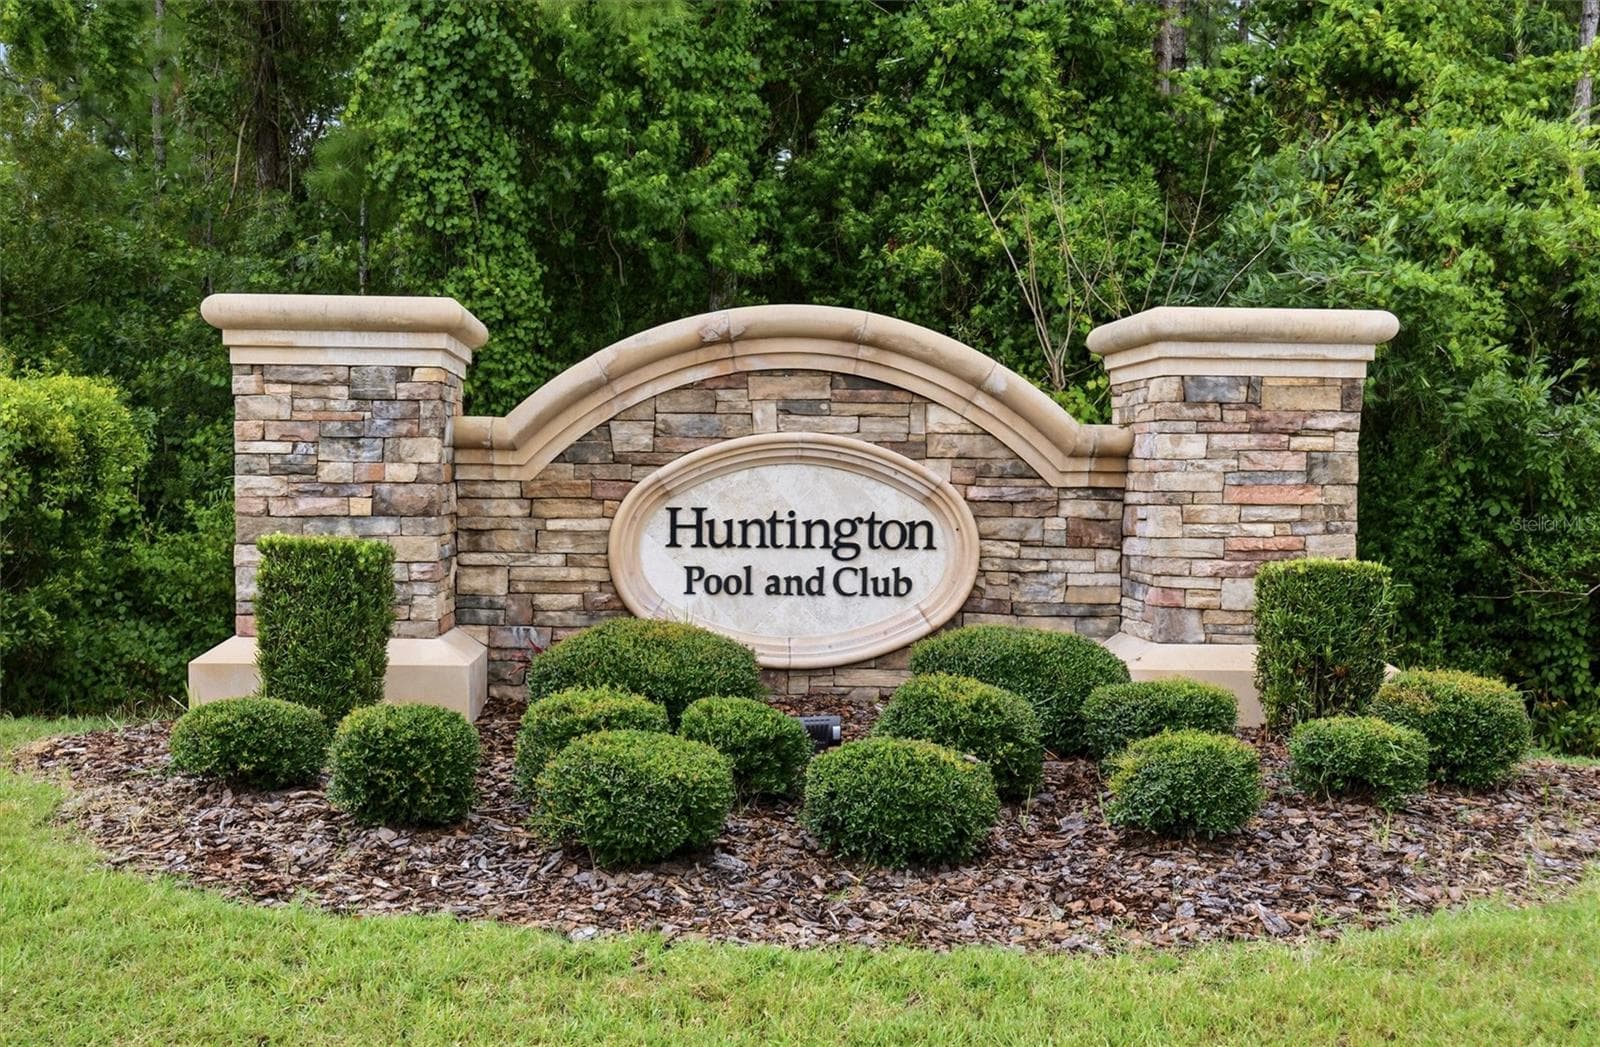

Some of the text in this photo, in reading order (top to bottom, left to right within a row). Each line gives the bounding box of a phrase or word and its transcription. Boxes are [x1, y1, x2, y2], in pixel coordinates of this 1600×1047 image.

[665, 506, 937, 562] Huntington
[683, 565, 913, 598] Pool and Club
